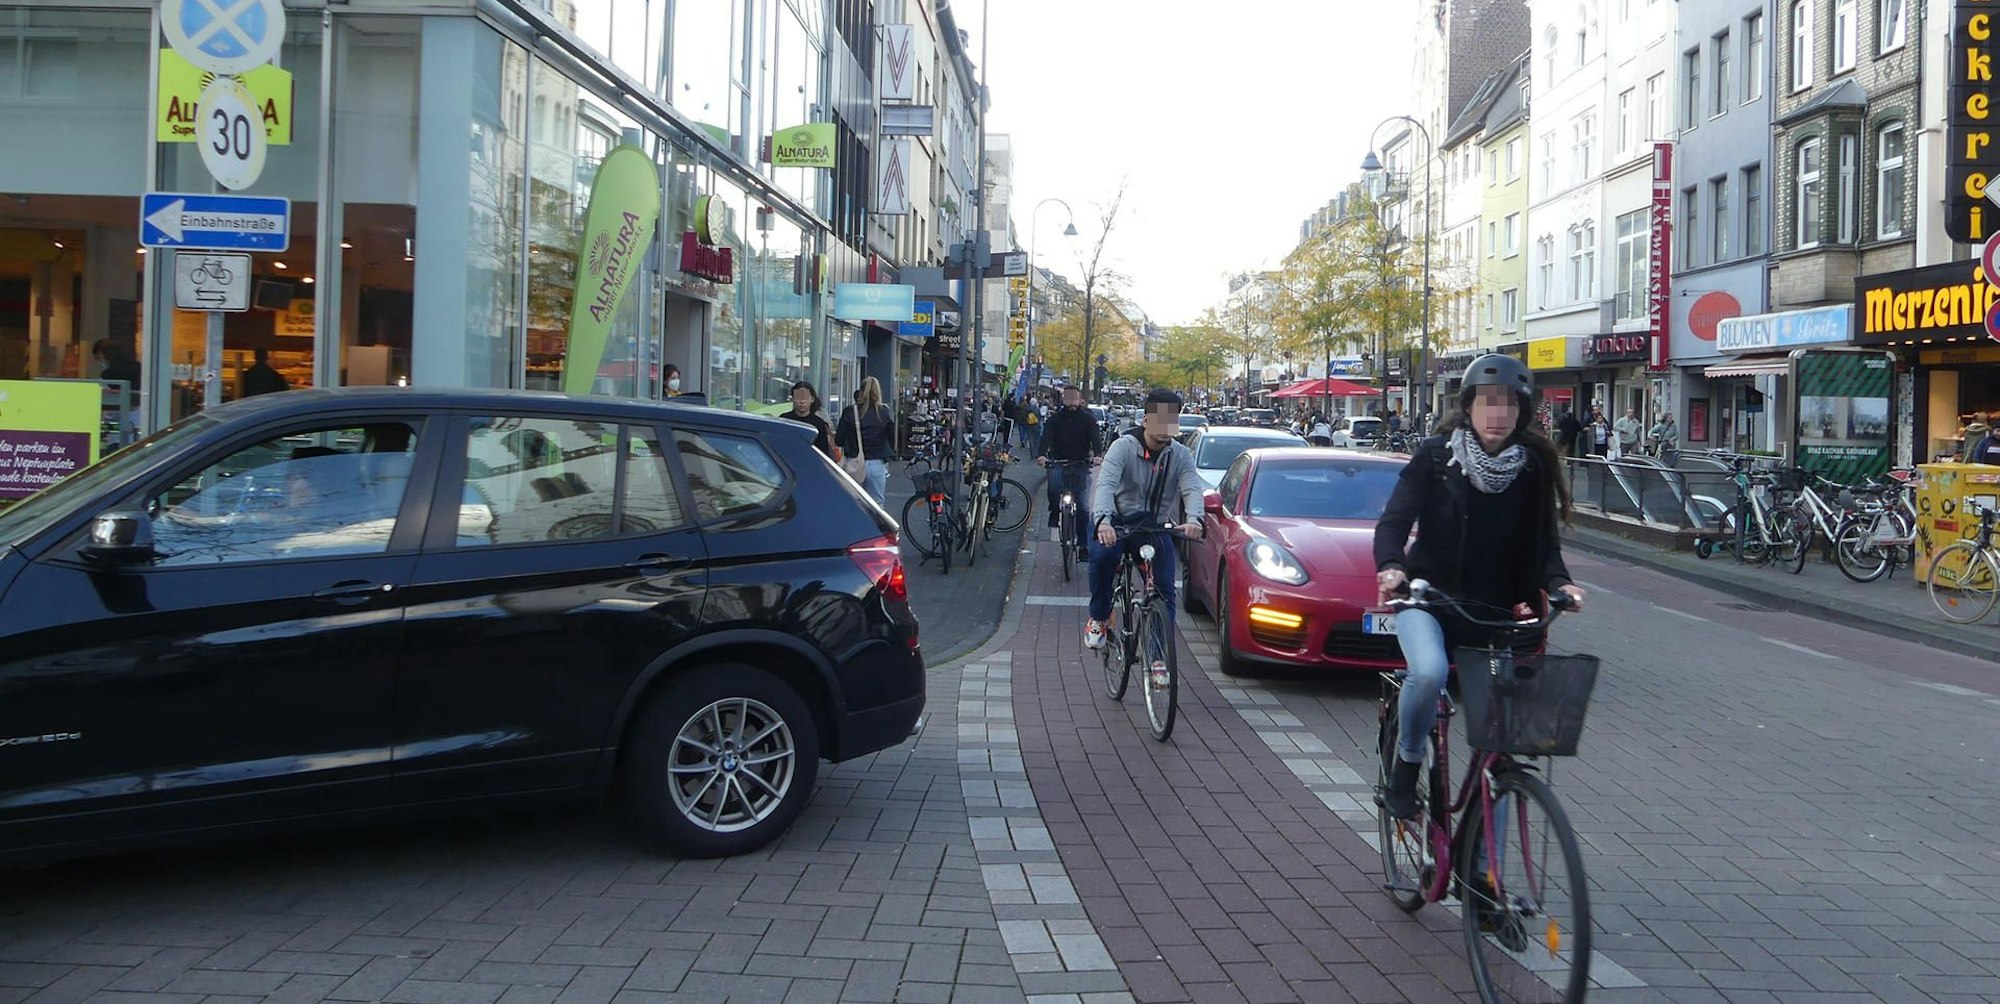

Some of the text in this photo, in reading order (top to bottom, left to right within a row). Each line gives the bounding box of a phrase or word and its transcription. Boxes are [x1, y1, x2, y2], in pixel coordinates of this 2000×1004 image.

[1965, 0, 1992, 239] ckerei
[213, 108, 250, 160] 30
[180, 214, 276, 231] Einbahnstraße
[589, 210, 640, 325] ALNATURA
[1596, 334, 1645, 356] unique
[1720, 319, 1771, 348] BLUMEN
[14, 441, 50, 456] parken
[52, 442, 67, 454] im
[1379, 617, 1388, 632] K
